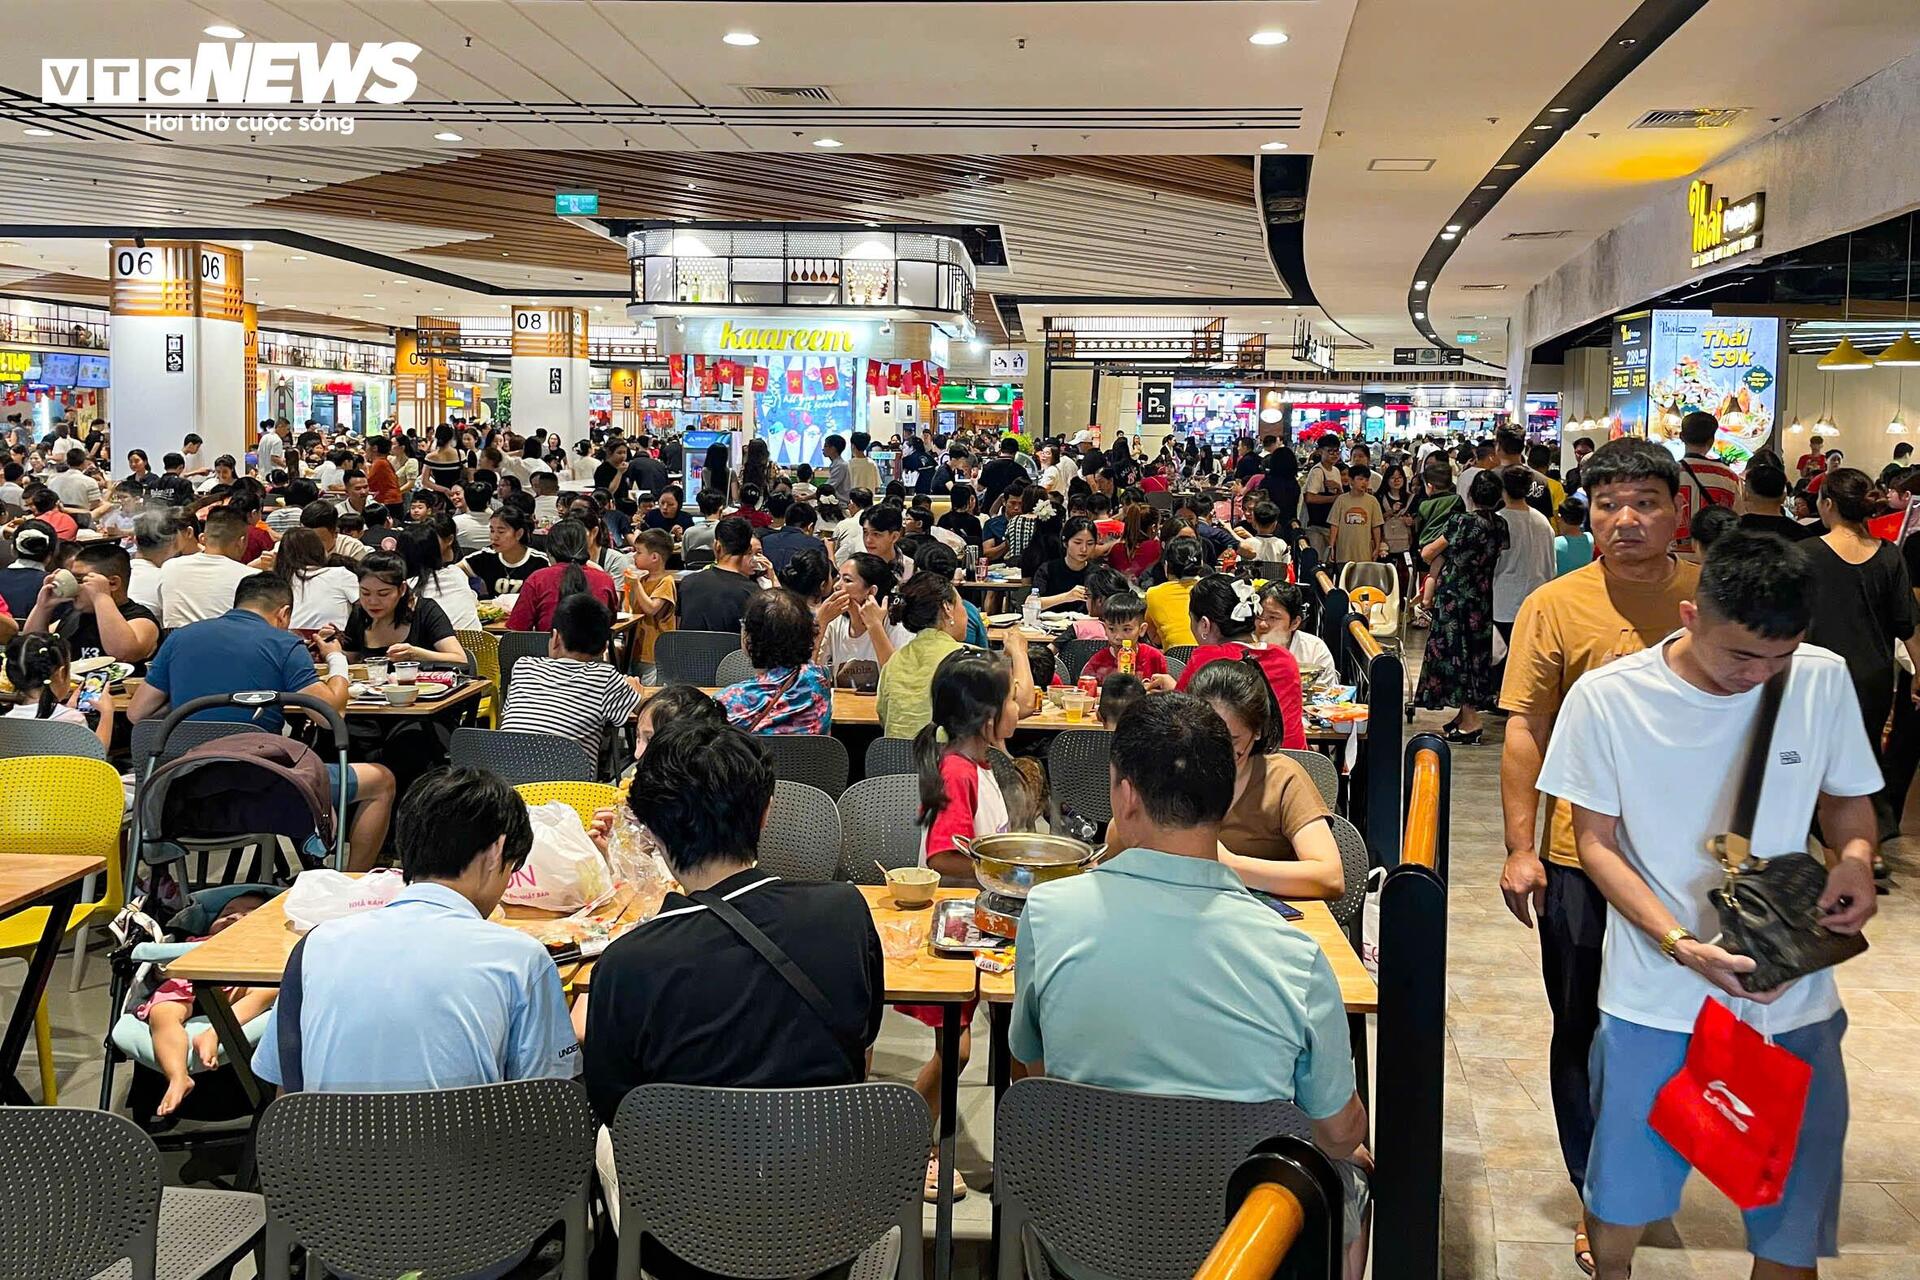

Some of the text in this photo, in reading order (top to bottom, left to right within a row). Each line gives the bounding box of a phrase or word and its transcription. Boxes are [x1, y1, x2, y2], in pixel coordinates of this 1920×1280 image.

[118, 252, 153, 276] 06
[201, 254, 220, 280] 06
[517, 313, 542, 330] 08
[244, 331, 256, 347] 07
[720, 320, 855, 352] kaareem
[623, 379, 632, 388] 13
[1148, 397, 1160, 413] P
[495, 578, 523, 594] 07
[81, 647, 100, 660] Y-3
